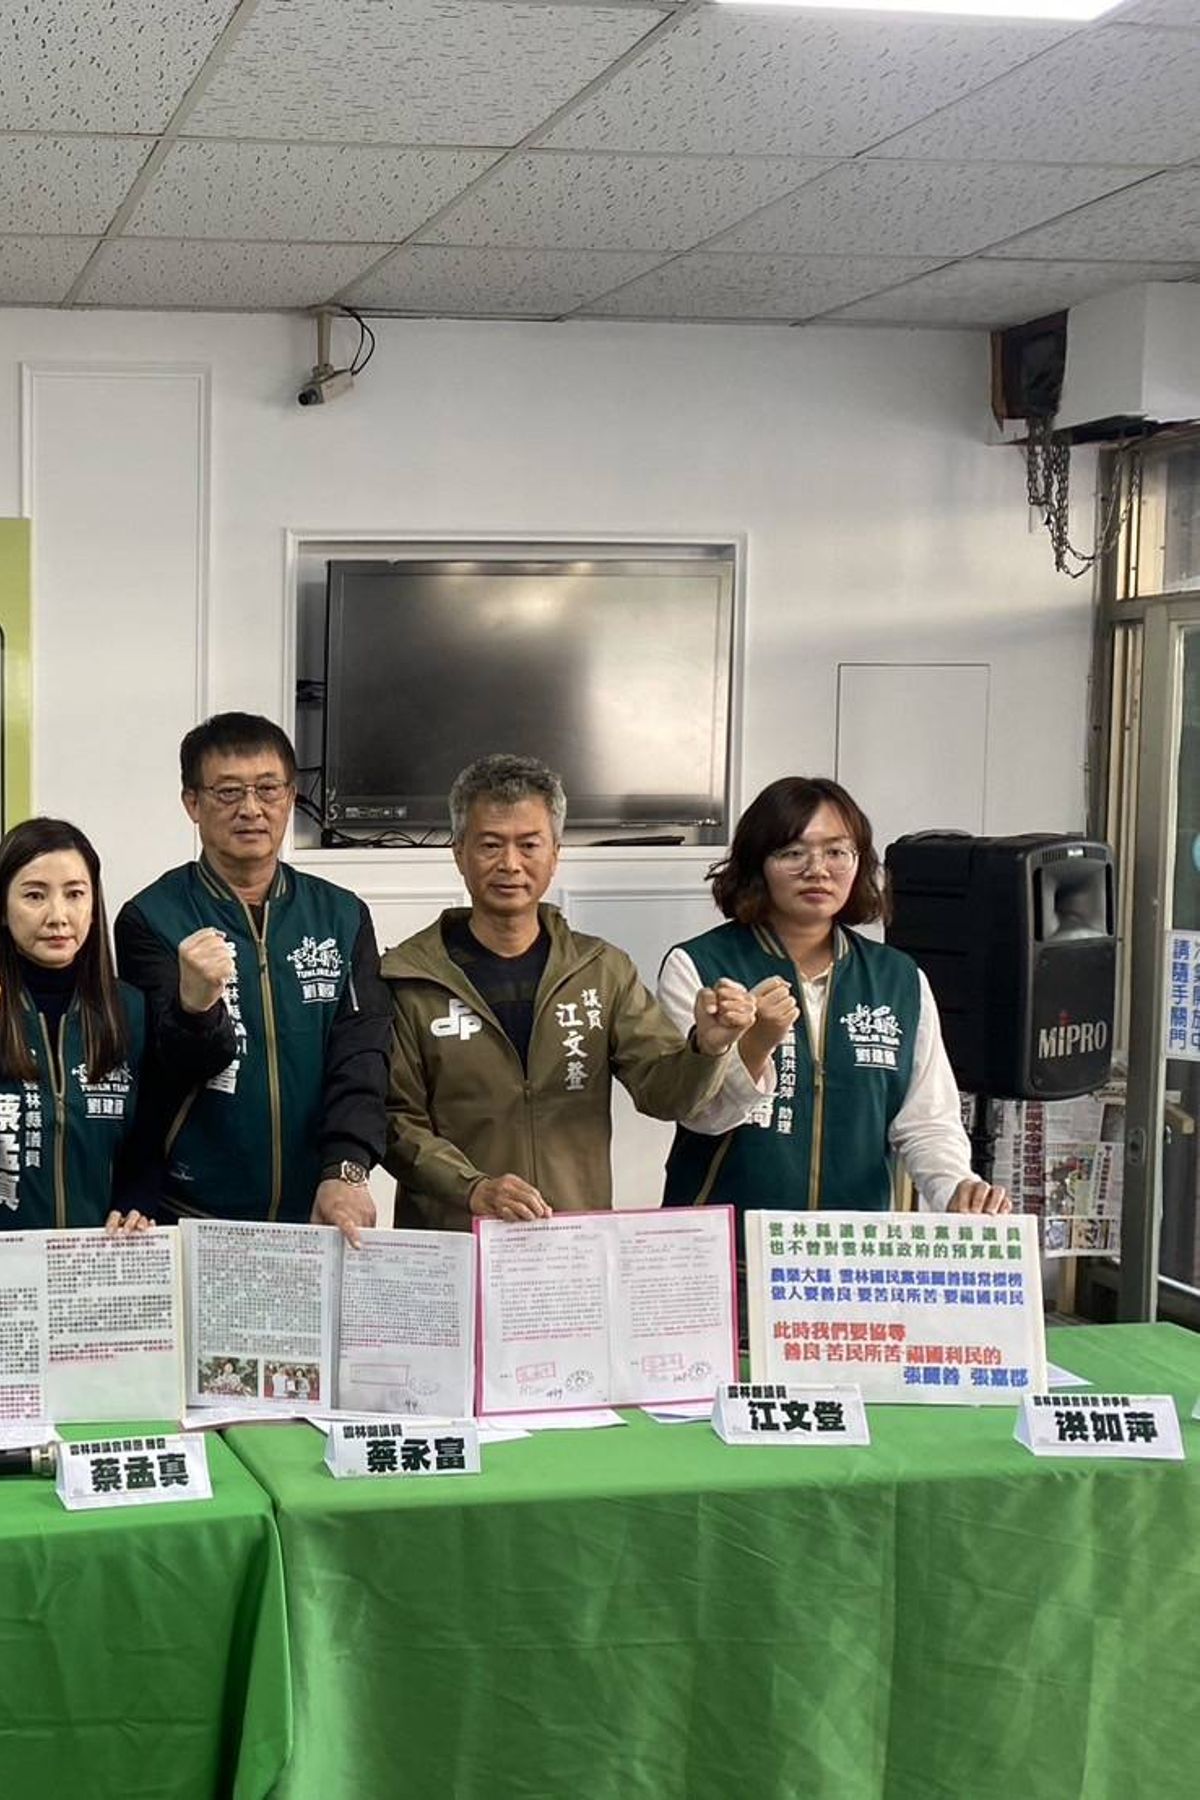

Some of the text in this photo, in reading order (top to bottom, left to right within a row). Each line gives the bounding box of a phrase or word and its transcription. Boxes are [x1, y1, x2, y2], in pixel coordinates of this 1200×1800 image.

[556, 1003, 589, 1091] 江文登
[1038, 1020, 1107, 1060] MIPRO
[748, 1401, 846, 1431] 江文登
[1054, 1411, 1158, 1443] 洪如萍
[90, 1453, 190, 1493] 蔡孟真
[366, 1437, 466, 1473] 蔡永富
